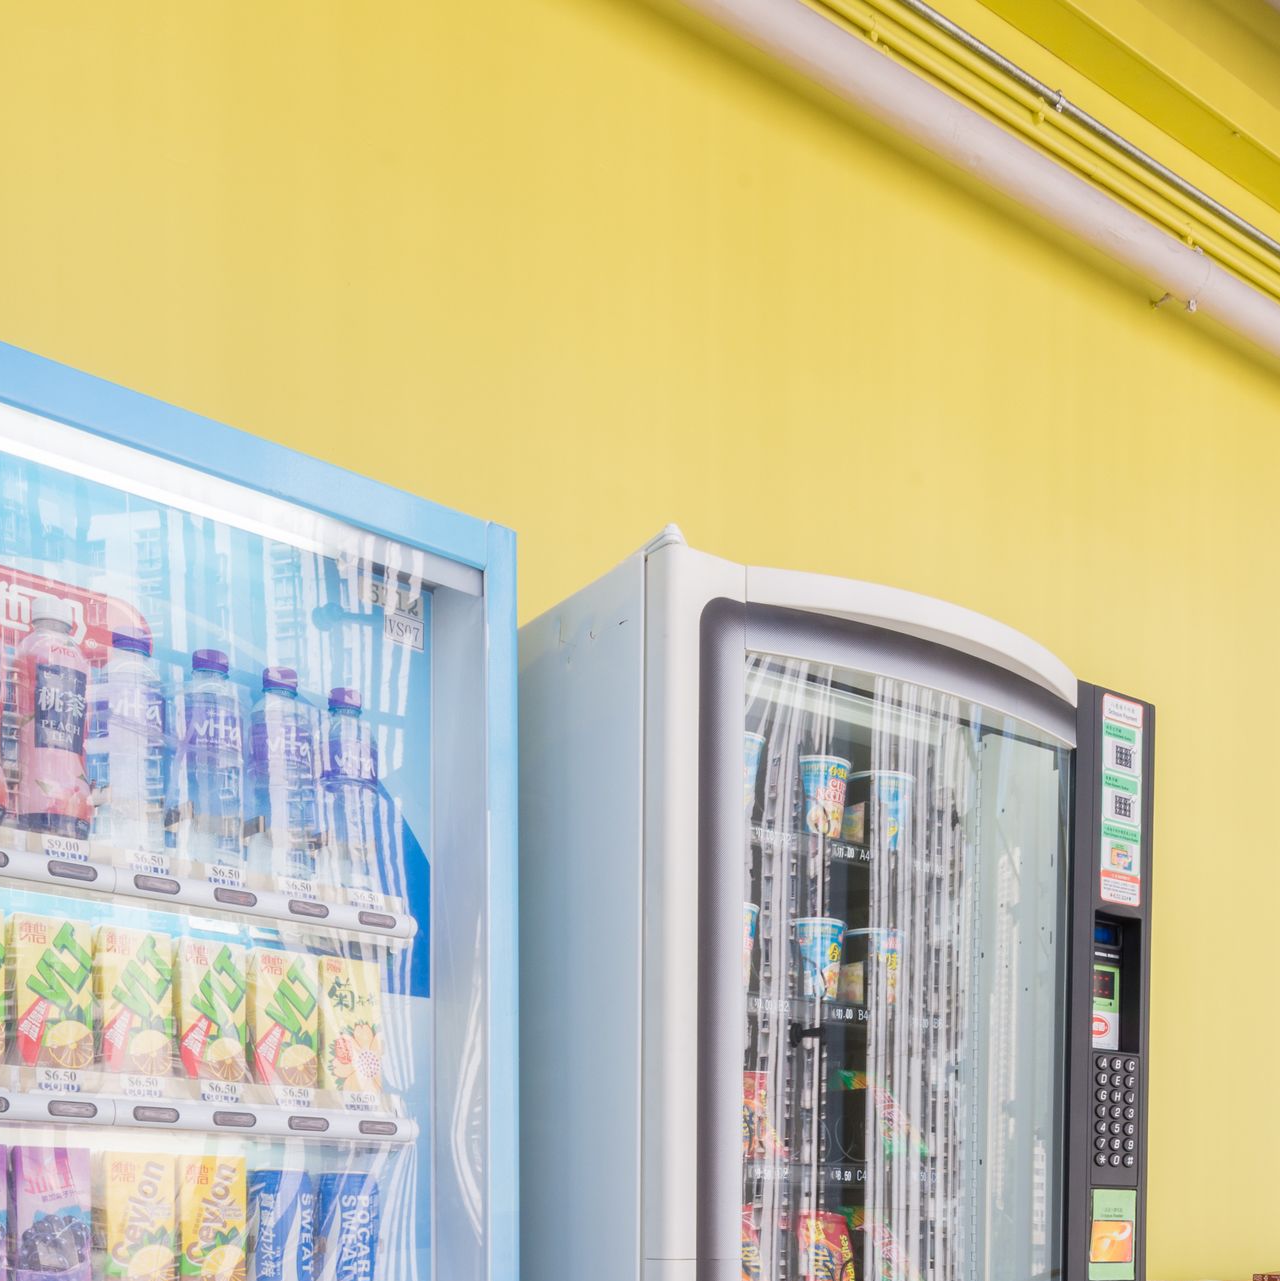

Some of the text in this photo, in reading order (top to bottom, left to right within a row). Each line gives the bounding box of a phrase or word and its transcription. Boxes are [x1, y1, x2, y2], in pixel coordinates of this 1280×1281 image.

[39, 686, 86, 718] 桃茶
[41, 718, 81, 735] PEACH
[51, 730, 74, 744] TEA
[46, 838, 80, 852] $9.00
[133, 853, 164, 866] $6.50
[859, 850, 870, 861] A4
[211, 866, 240, 880] $6.50
[284, 879, 312, 892] $6.50
[858, 1010, 868, 1021] B4
[1101, 1058, 1135, 1071] A B C
[44, 1069, 78, 1083] $6.50
[127, 1076, 159, 1089] $6.50
[1101, 1074, 1135, 1086] D E F
[207, 1083, 237, 1095] $6.50
[280, 1088, 310, 1100] $6.50
[349, 1093, 376, 1105] $6.50
[1100, 1090, 1135, 1103] G H J
[1101, 1107, 1134, 1118] 1 2 3
[1100, 1122, 1134, 1134] 4 5 6
[1100, 1138, 1134, 1150] 7 8 9
[857, 1169, 868, 1181] C4
[112, 1160, 165, 1267] Ceylon
[185, 1162, 237, 1266] Ceylon
[301, 1193, 314, 1274] SWEAT
[342, 1194, 357, 1273] SWEAT
[357, 1195, 370, 1281] POCARI
